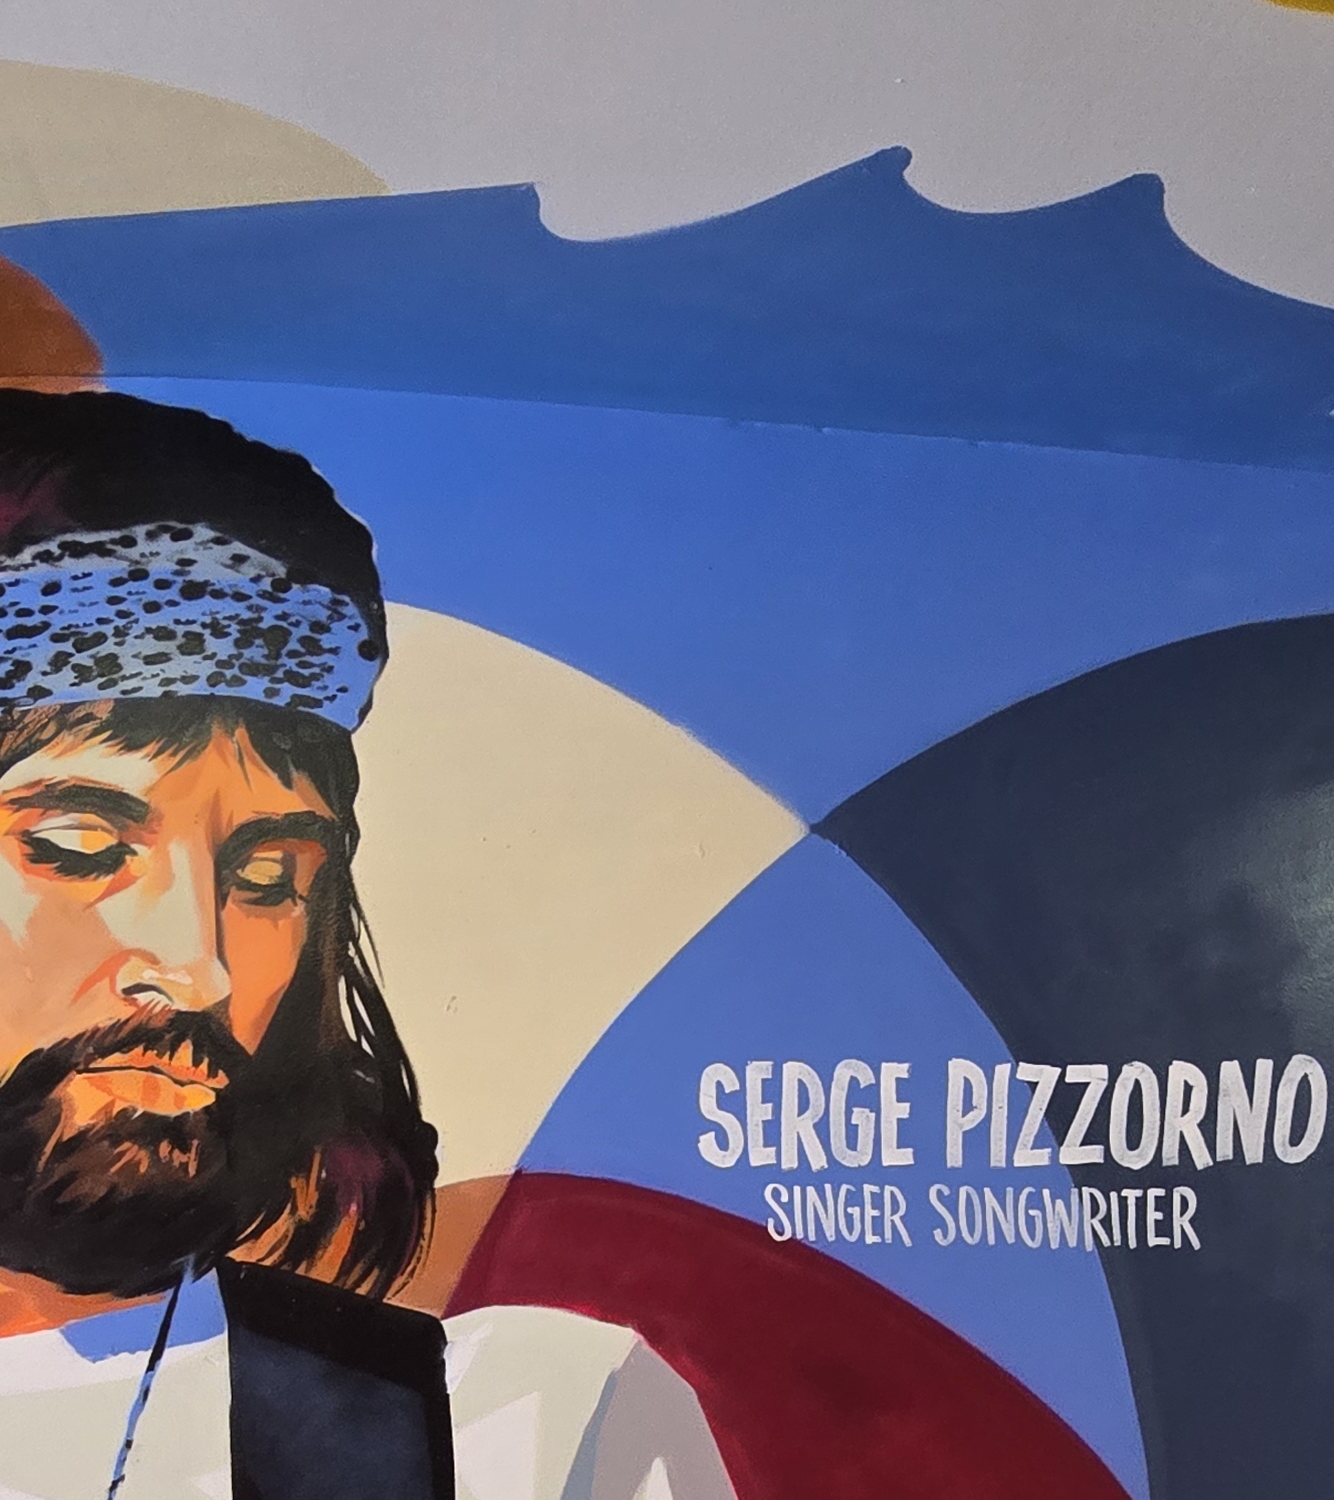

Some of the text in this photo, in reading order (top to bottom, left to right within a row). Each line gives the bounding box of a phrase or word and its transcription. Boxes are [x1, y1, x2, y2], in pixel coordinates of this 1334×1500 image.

[696, 1053, 1329, 1171] SERGE PIZZORNO
[763, 1182, 1202, 1252] SINGER SONGWRITER
